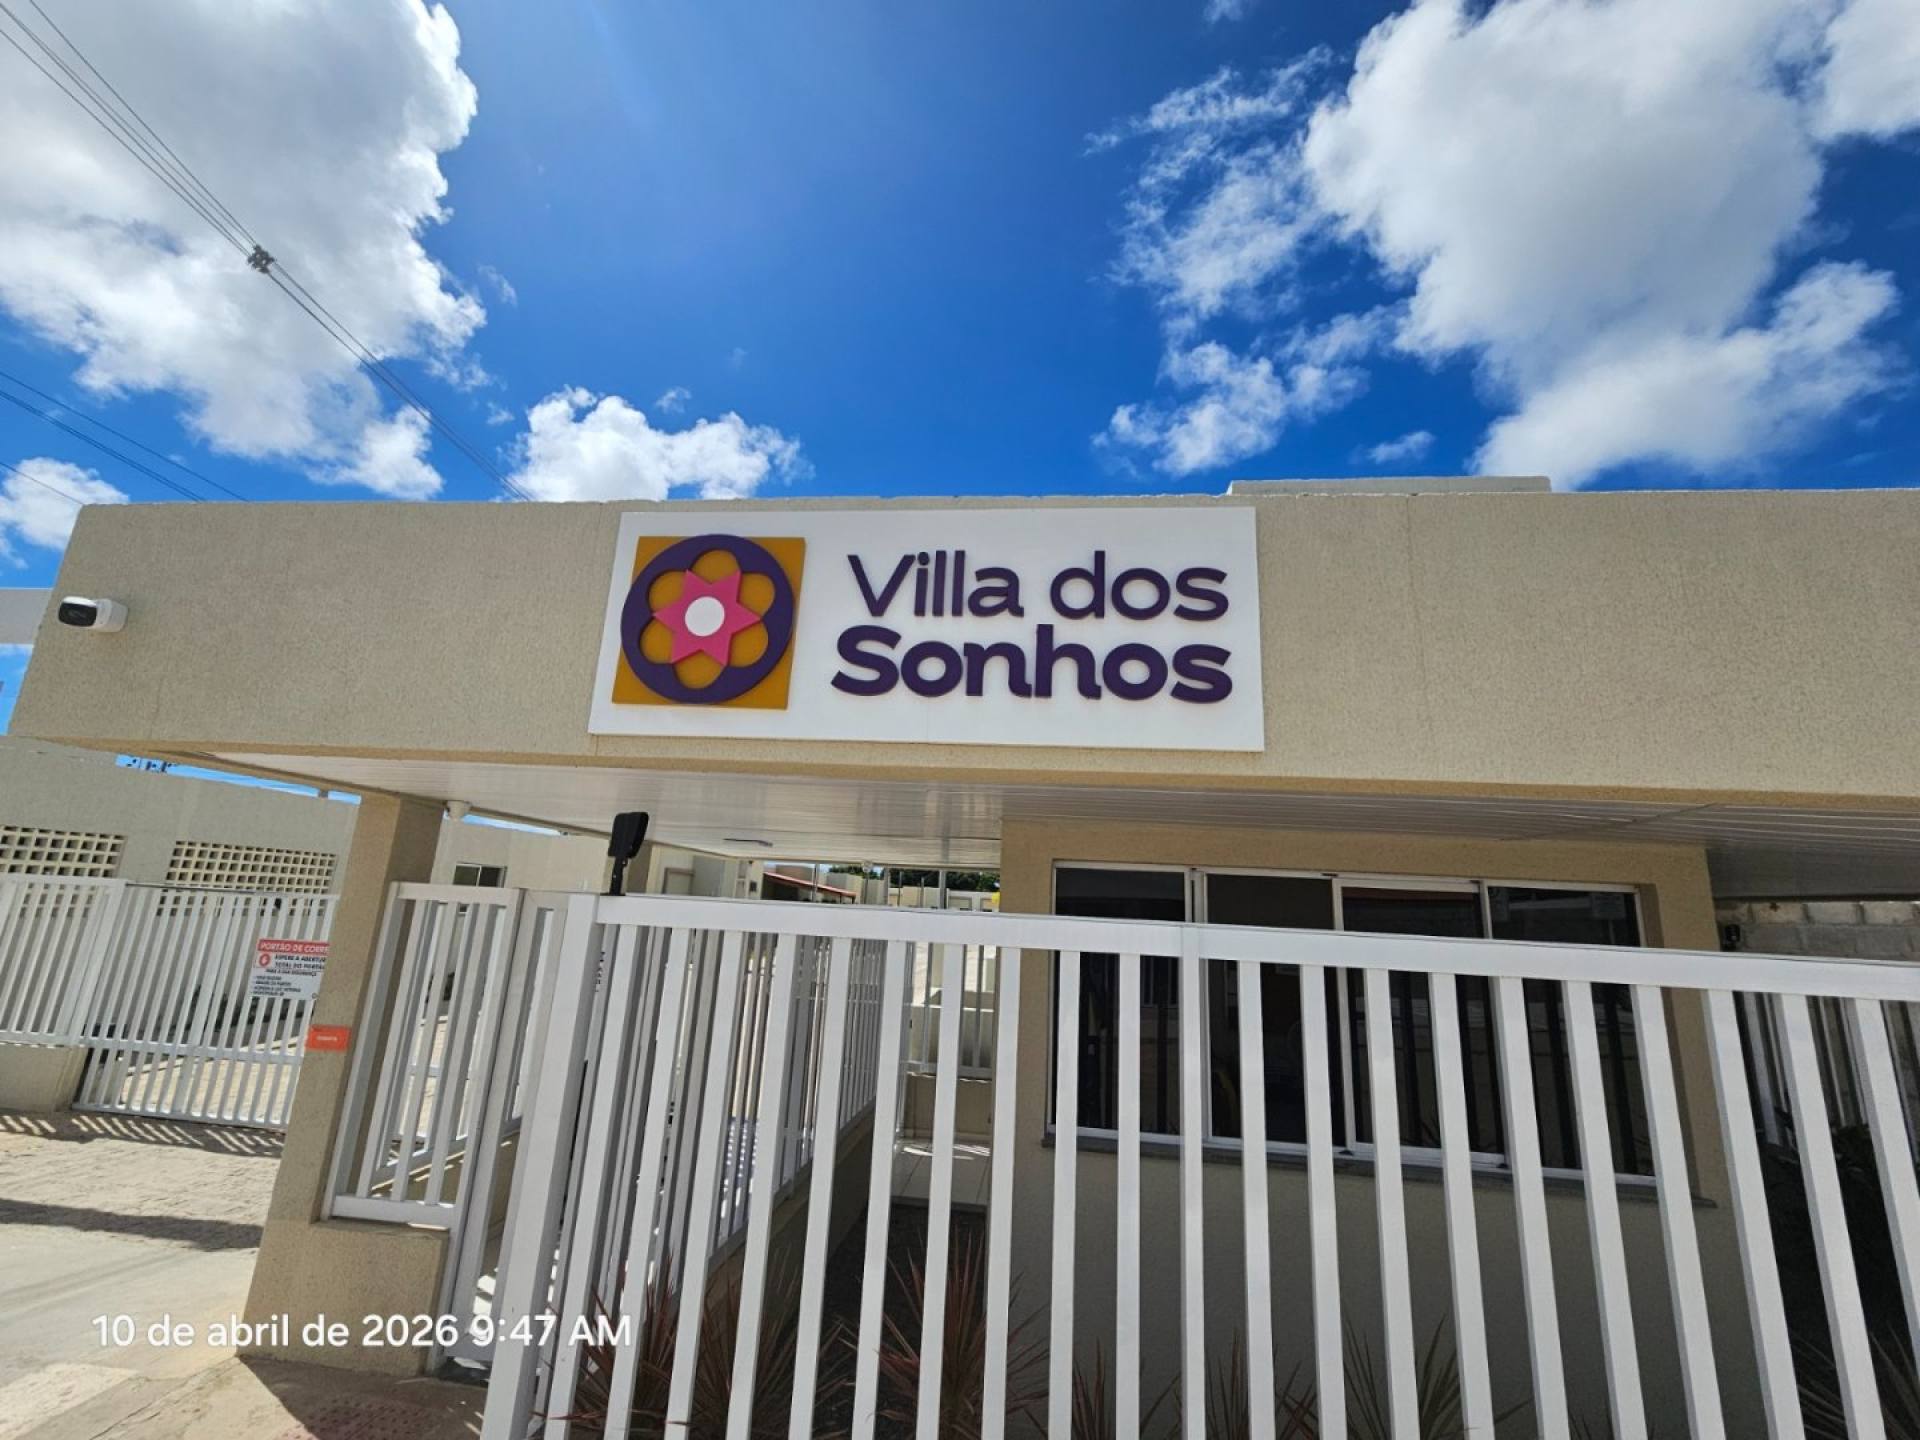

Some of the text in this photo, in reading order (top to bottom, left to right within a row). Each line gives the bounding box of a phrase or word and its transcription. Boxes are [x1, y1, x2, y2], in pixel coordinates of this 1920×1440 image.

[846, 549, 1230, 623] Villa dos
[830, 623, 1234, 705] Sonhos
[261, 942, 291, 951] PORTÃO
[292, 944, 303, 953] DE
